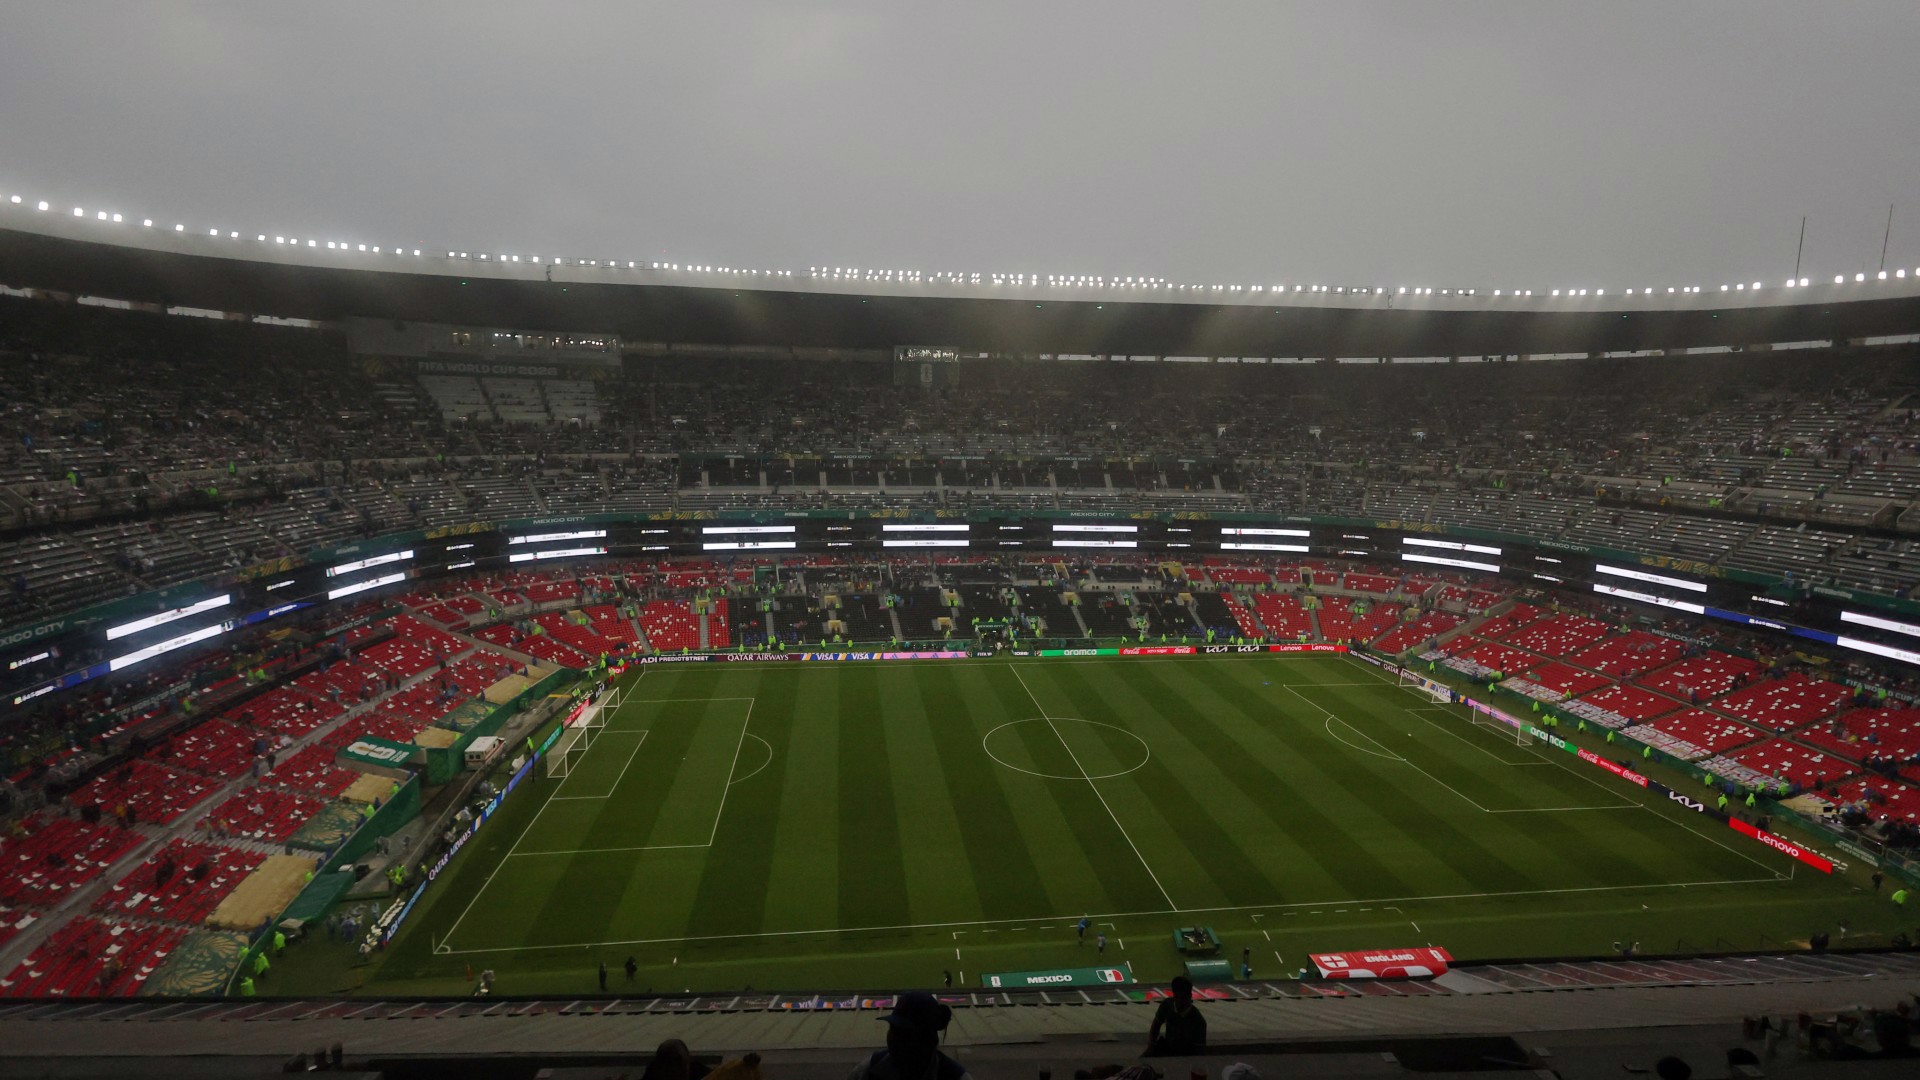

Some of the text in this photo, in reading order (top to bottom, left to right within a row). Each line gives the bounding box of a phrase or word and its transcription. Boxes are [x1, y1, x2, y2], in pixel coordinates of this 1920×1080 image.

[445, 363, 490, 374] WORLD
[492, 365, 516, 374] CUP
[517, 366, 558, 376] 2026
[1539, 540, 1570, 549] MEXICO
[35, 620, 65, 636] CITY
[1651, 628, 1687, 642] MEXICO
[727, 652, 789, 661] QATAR AIRWAYS
[816, 652, 834, 661] VISA
[851, 652, 870, 660] VISA
[1063, 648, 1097, 656] aramco
[640, 656, 658, 664] ADI
[1383, 663, 1399, 675] QATAR
[1437, 685, 1451, 698] VISA
[1529, 726, 1566, 749] aramco
[1756, 830, 1800, 858] Lenovo
[429, 853, 449, 881] QATAR
[1363, 953, 1415, 963] ENGLAND
[1026, 974, 1073, 984] MEXICO
